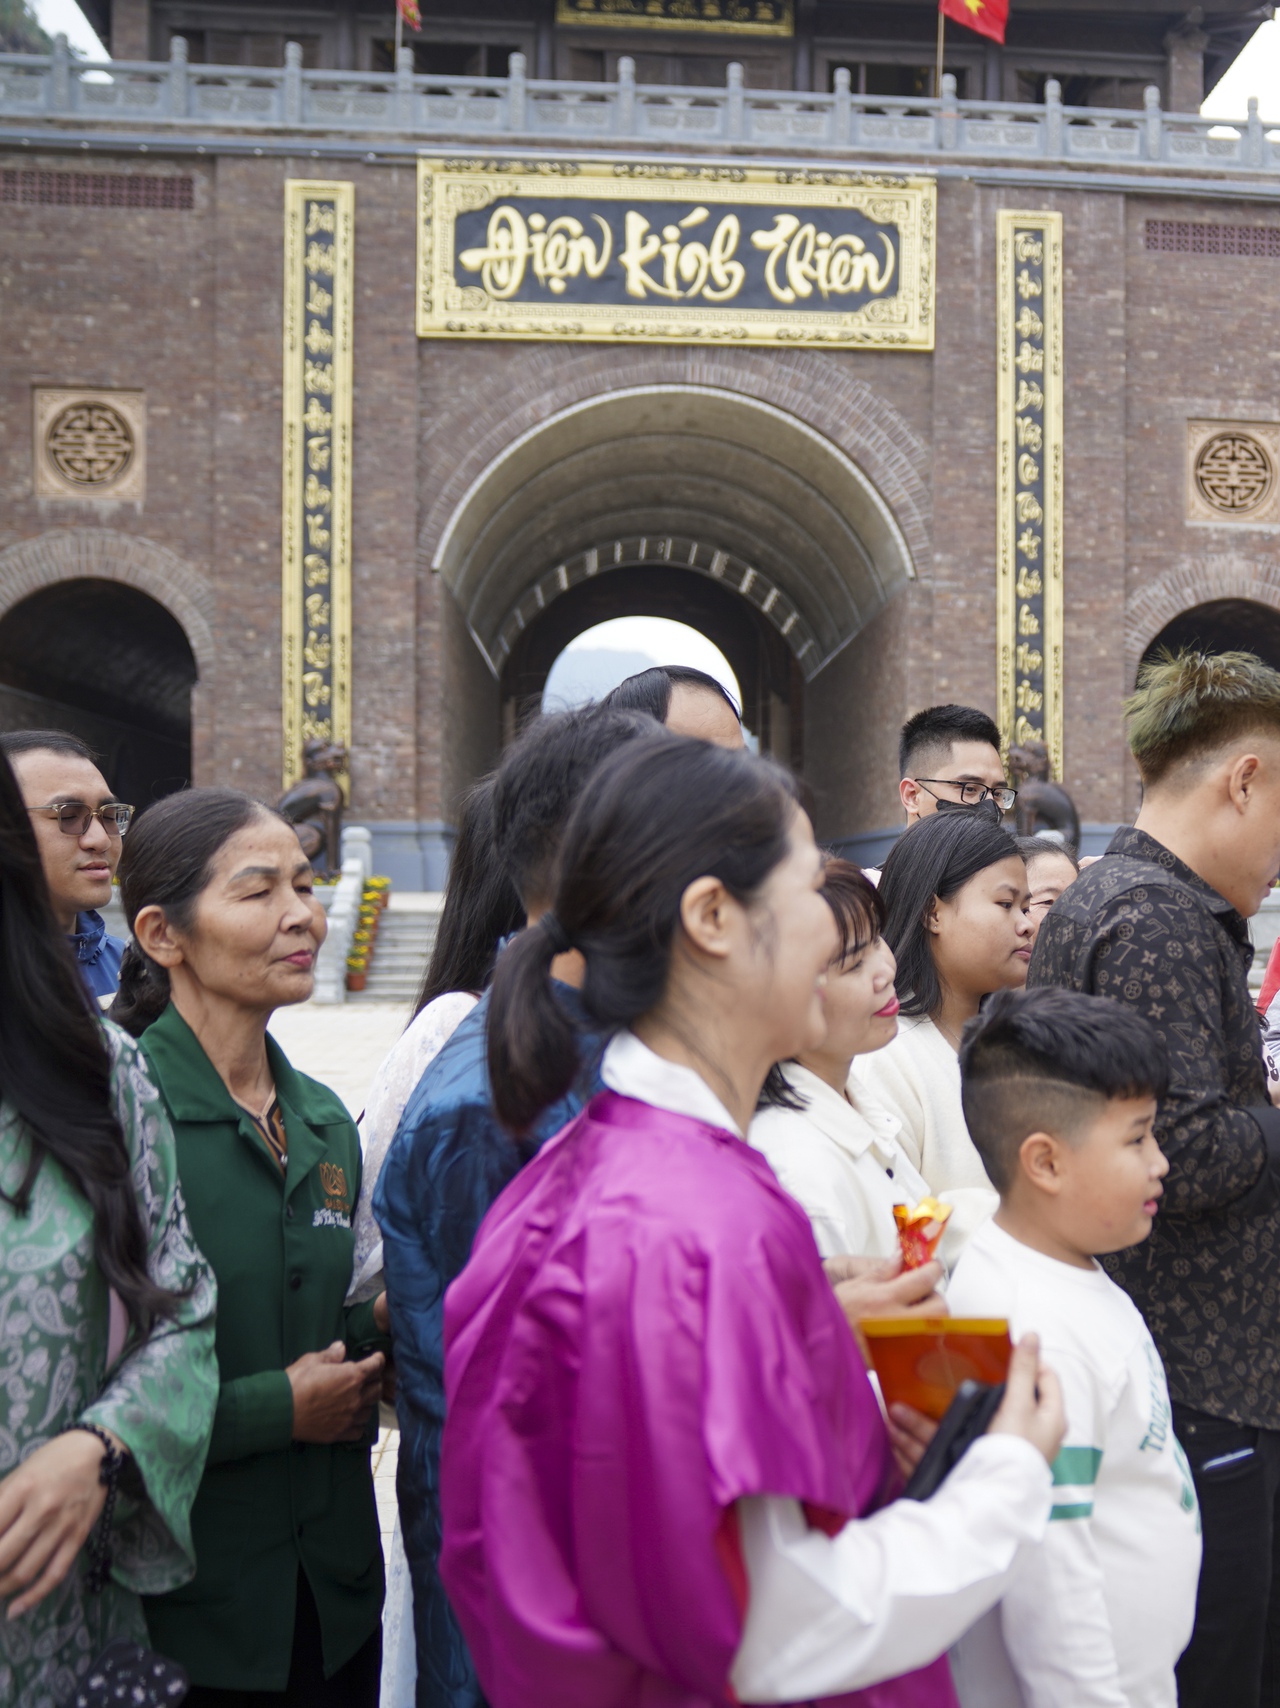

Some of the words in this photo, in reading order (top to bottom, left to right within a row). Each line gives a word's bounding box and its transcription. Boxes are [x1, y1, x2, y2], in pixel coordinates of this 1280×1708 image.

[459, 205, 612, 299] Điện
[619, 206, 746, 302] Kính
[751, 213, 896, 304] Thiên
